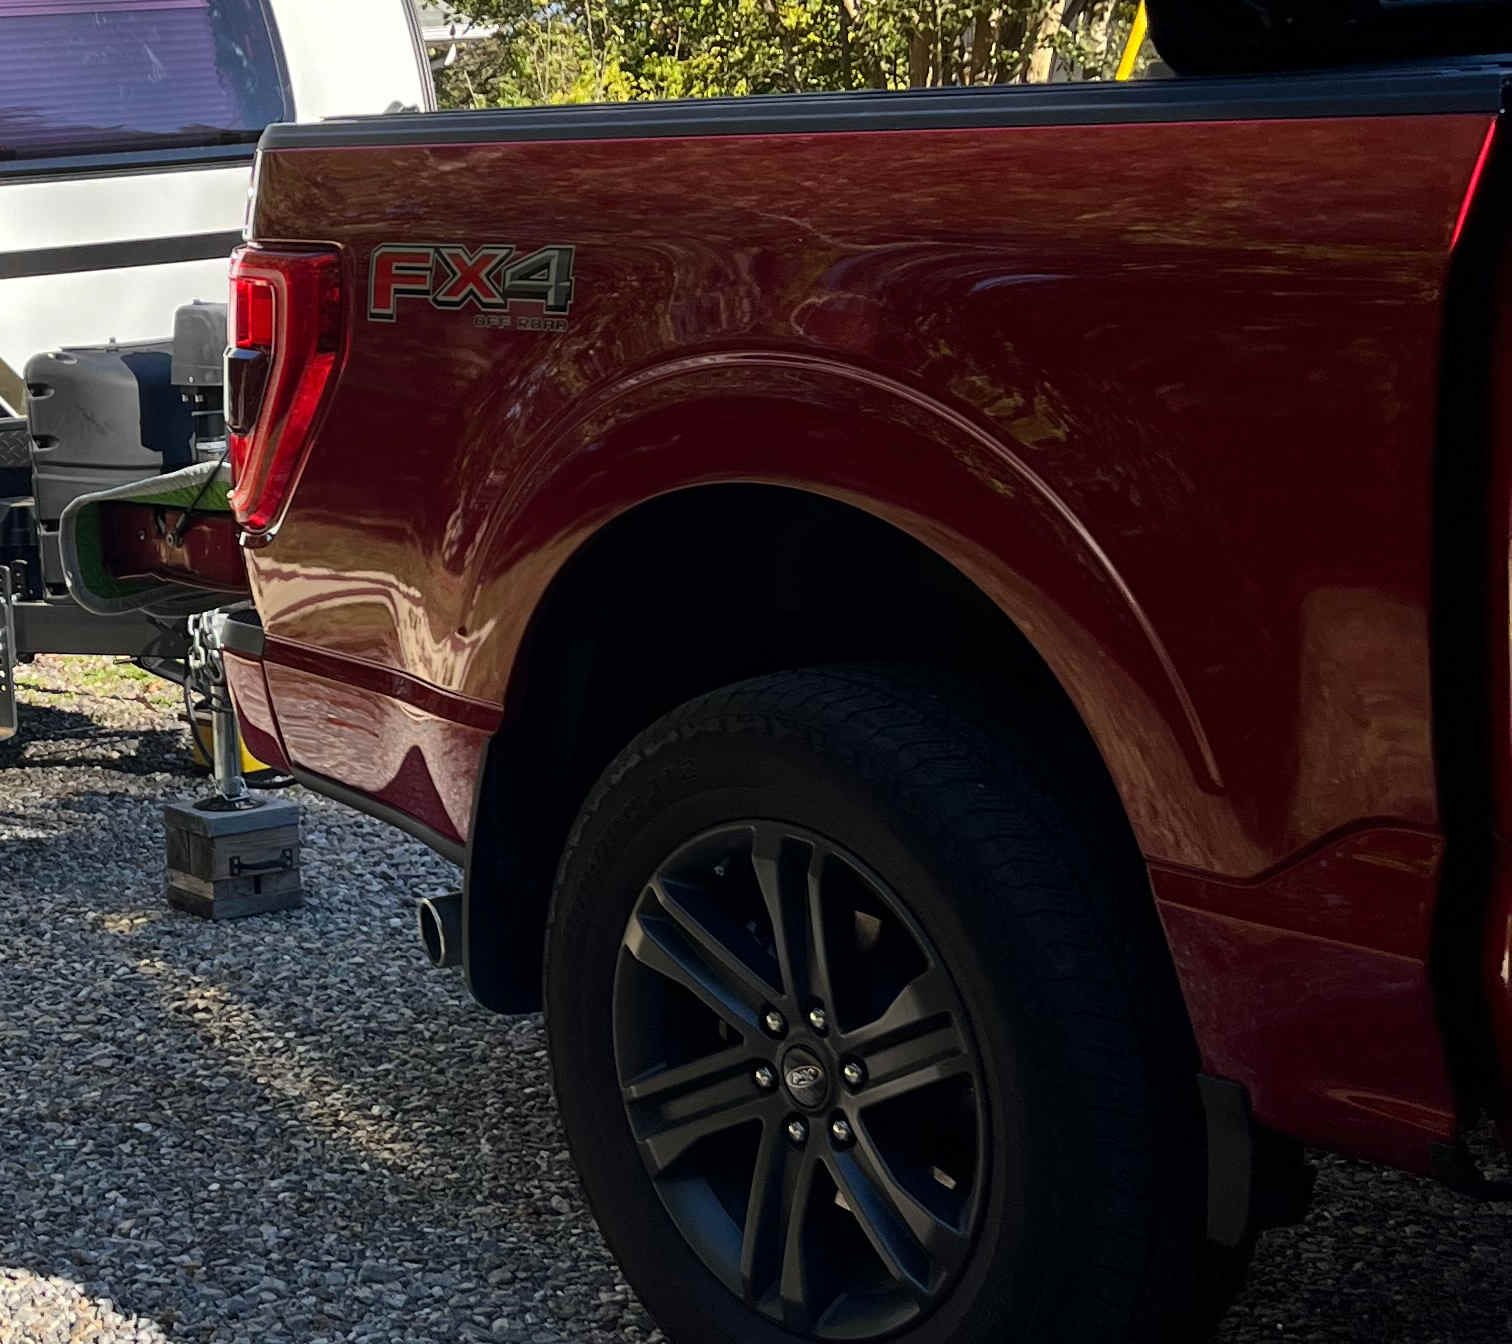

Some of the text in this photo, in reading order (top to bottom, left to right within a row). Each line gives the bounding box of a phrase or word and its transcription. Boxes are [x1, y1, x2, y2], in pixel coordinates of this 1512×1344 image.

[368, 243, 576, 323] FX4
[472, 314, 569, 332] OFF ROAD
